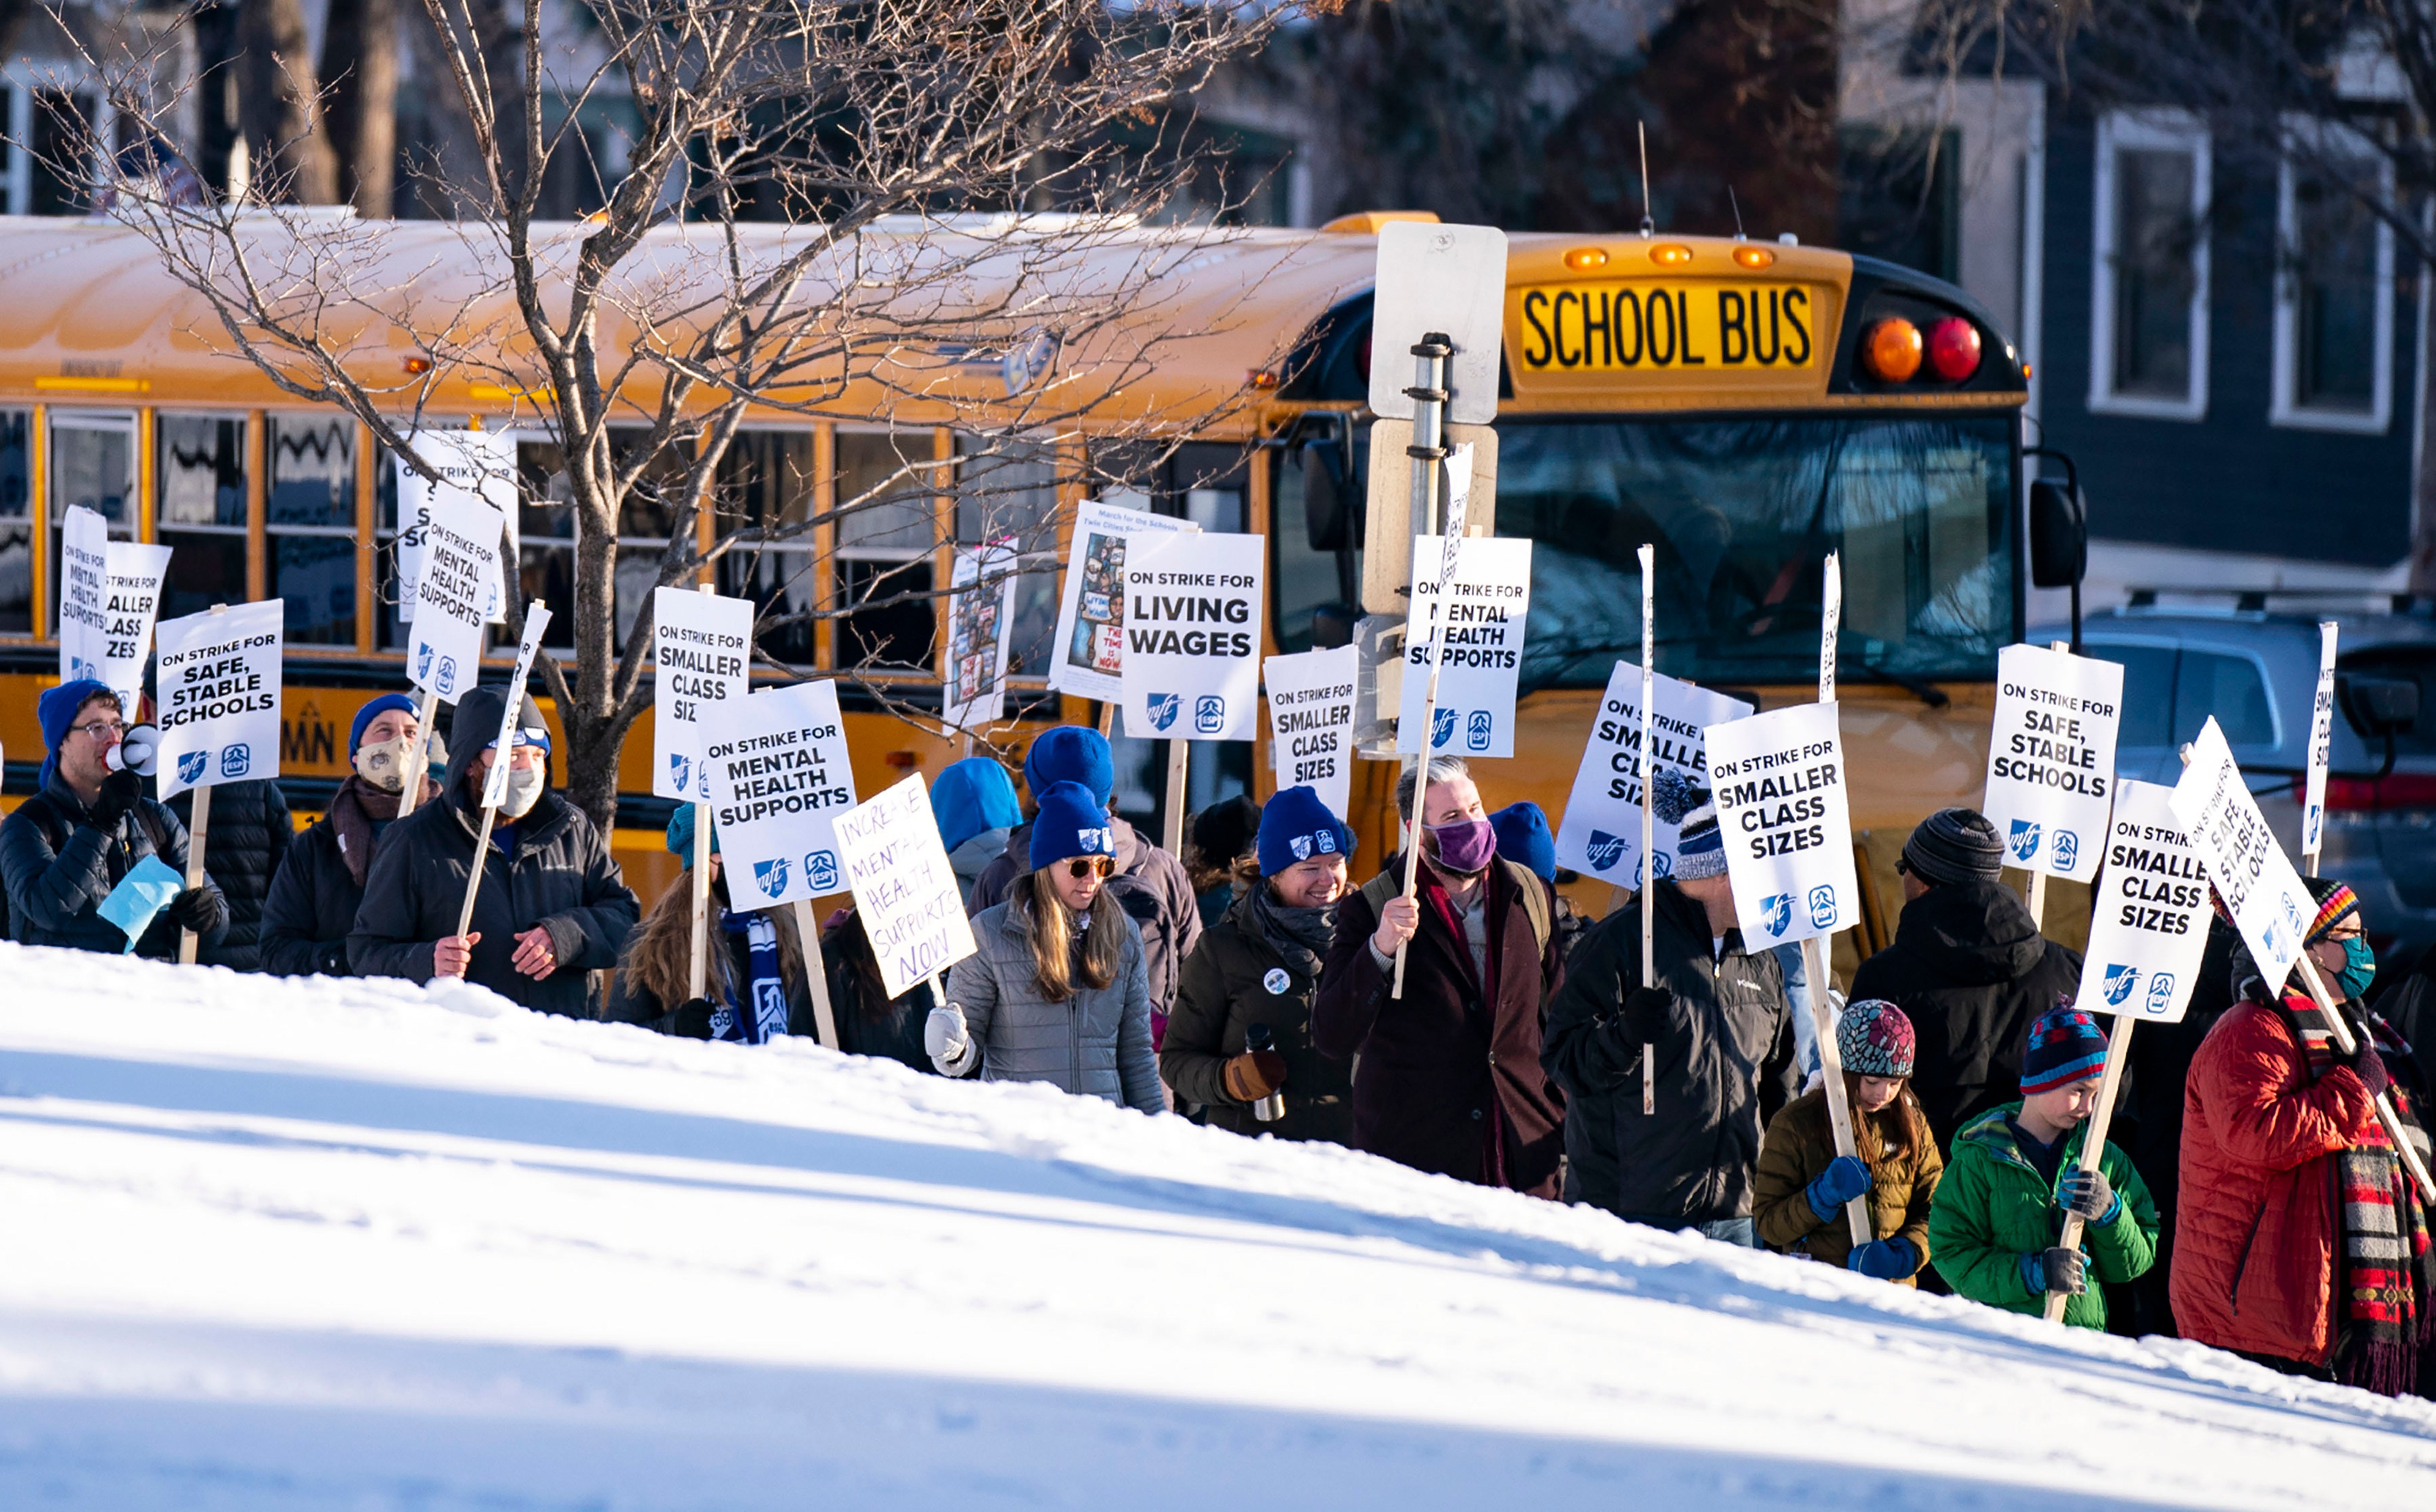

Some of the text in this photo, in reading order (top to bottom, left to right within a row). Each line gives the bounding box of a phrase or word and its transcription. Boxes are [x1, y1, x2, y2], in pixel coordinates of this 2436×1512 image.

[1524, 288, 1809, 367] SCHOOL BUS
[436, 466, 478, 477] TRIKE
[1084, 518, 1100, 527] Twin
[1103, 521, 1124, 532] Cities
[1099, 510, 1122, 519] March
[1149, 520, 1178, 531] Schools
[431, 523, 443, 539] ON
[444, 532, 475, 555] STRIKE
[476, 546, 493, 564] FOR
[92, 554, 104, 568] FOR
[433, 545, 479, 583] MENTAL
[142, 578, 156, 589] FOR
[430, 565, 476, 602] HEALTH
[1130, 572, 1254, 588] ON STRIKE FOR
[1418, 582, 1523, 597] ON TRIKE FOR
[63, 602, 104, 629] SUPORTS
[107, 595, 152, 613] ALLER
[420, 583, 480, 627] SUPPORTS
[1134, 595, 1249, 623] LIVING
[105, 617, 141, 636] LASS
[660, 625, 743, 649] ON STRIKE FOR
[1429, 626, 1504, 645] EALTH
[107, 641, 136, 658] ZES
[162, 634, 275, 667] ON STRIKE FOR
[1104, 638, 1122, 649] TIME
[1129, 629, 1251, 657] WAGES
[184, 657, 249, 684] SAFE,
[660, 646, 742, 677] SMALLER
[1099, 658, 1120, 669] NOW
[173, 674, 261, 706] STABLE
[672, 675, 727, 700] CLASS
[1275, 684, 1352, 705] ON STRIKE FOR
[2003, 683, 2114, 717] ON STRIKE FOR
[161, 694, 274, 731] SCHOOLS
[674, 699, 697, 723] SIZ
[1203, 716, 1217, 724] ESP
[1278, 704, 1350, 734] SMALLER
[1608, 700, 1634, 718] ON
[709, 724, 837, 759] ON STRIKE FOR
[2025, 710, 2085, 745] SAFE,
[1292, 731, 1338, 757] CLASS
[1598, 720, 1707, 772] SMALLE
[2011, 734, 2096, 770] STABLE
[727, 747, 826, 780] MENTAL
[1295, 758, 1335, 783] SIZES
[1715, 740, 1832, 779] ON STRIKE FOR
[734, 768, 827, 801] HEALTH
[1719, 764, 1838, 809] SMALLER
[1994, 757, 2106, 797] SCHOOLS
[720, 786, 850, 826] SUPPORTS
[1741, 796, 1825, 832] CLASS
[2192, 759, 2232, 843] ON STRIKE FOR
[2118, 822, 2193, 848] ON STRIK
[2211, 797, 2241, 852] SAFE,
[1750, 825, 1824, 859] SIZES
[2056, 851, 2070, 861] ESP
[2221, 809, 2255, 883] STABLE
[852, 832, 927, 885] MENTAL
[2111, 845, 2207, 881] SMALLE
[2229, 824, 2270, 915] SCHOOLS
[815, 871, 831, 881] ESP
[866, 860, 933, 919] HEALTH
[2122, 877, 2202, 908] CLASS
[874, 890, 957, 958] SUPPORTS
[1818, 907, 1831, 918] ESP
[2119, 905, 2190, 934] SIZES
[900, 928, 949, 985] NOW
[714, 1010, 732, 1027] 59
